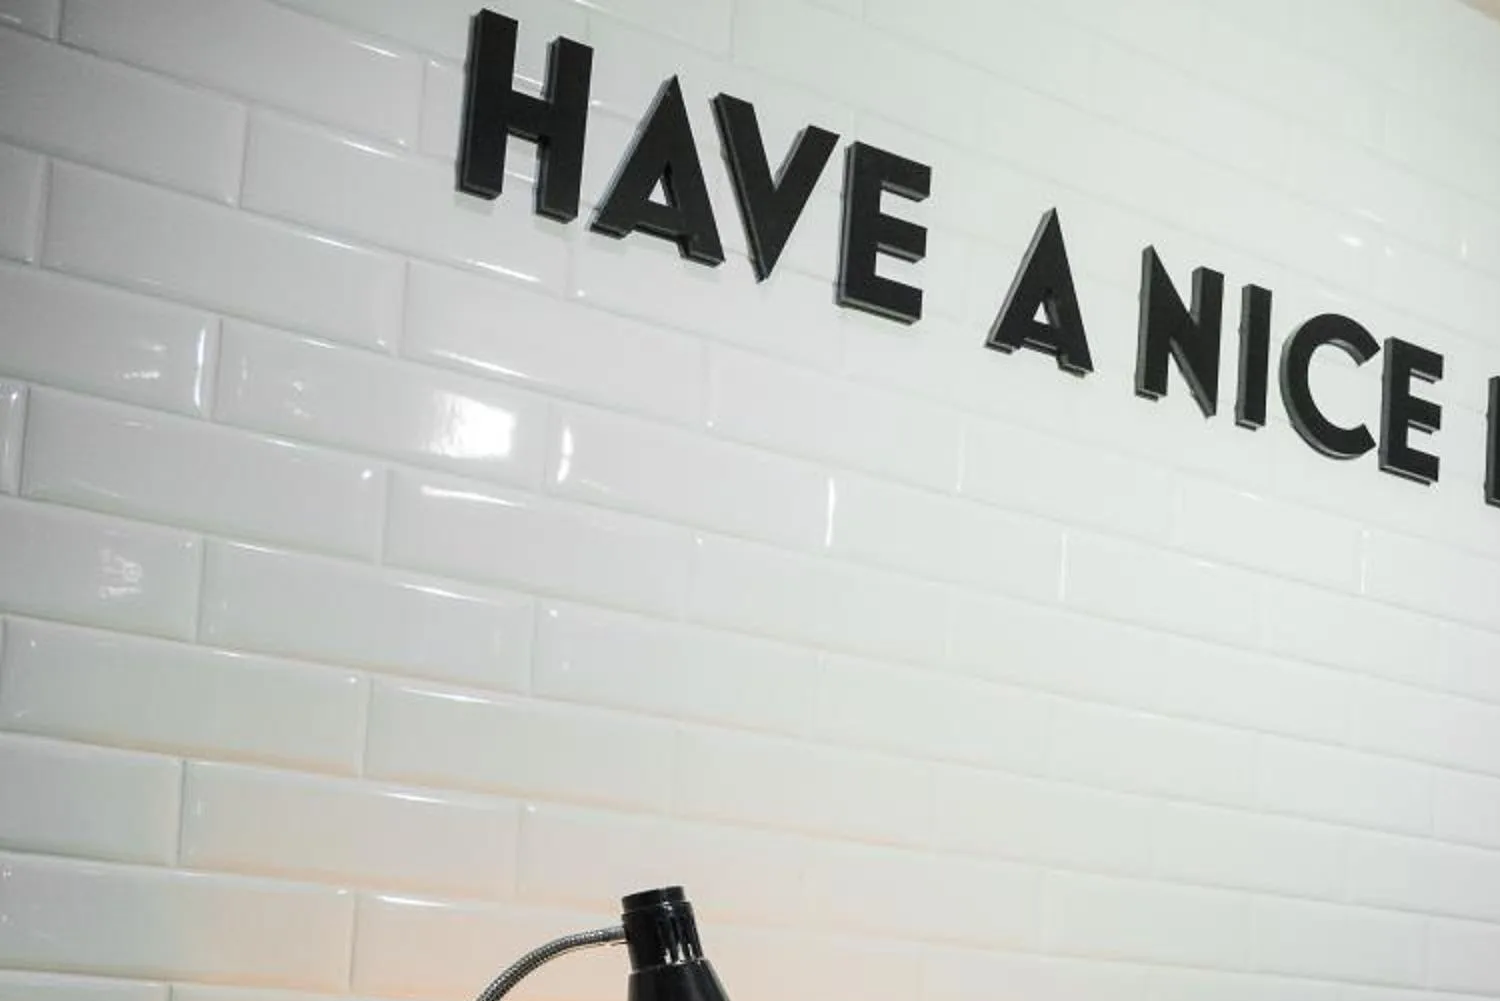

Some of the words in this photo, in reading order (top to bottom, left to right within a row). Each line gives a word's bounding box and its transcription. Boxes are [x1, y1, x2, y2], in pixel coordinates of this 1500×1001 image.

[455, 8, 933, 326] HAVE
[984, 207, 1096, 379] A
[1133, 245, 1445, 486] NICE
